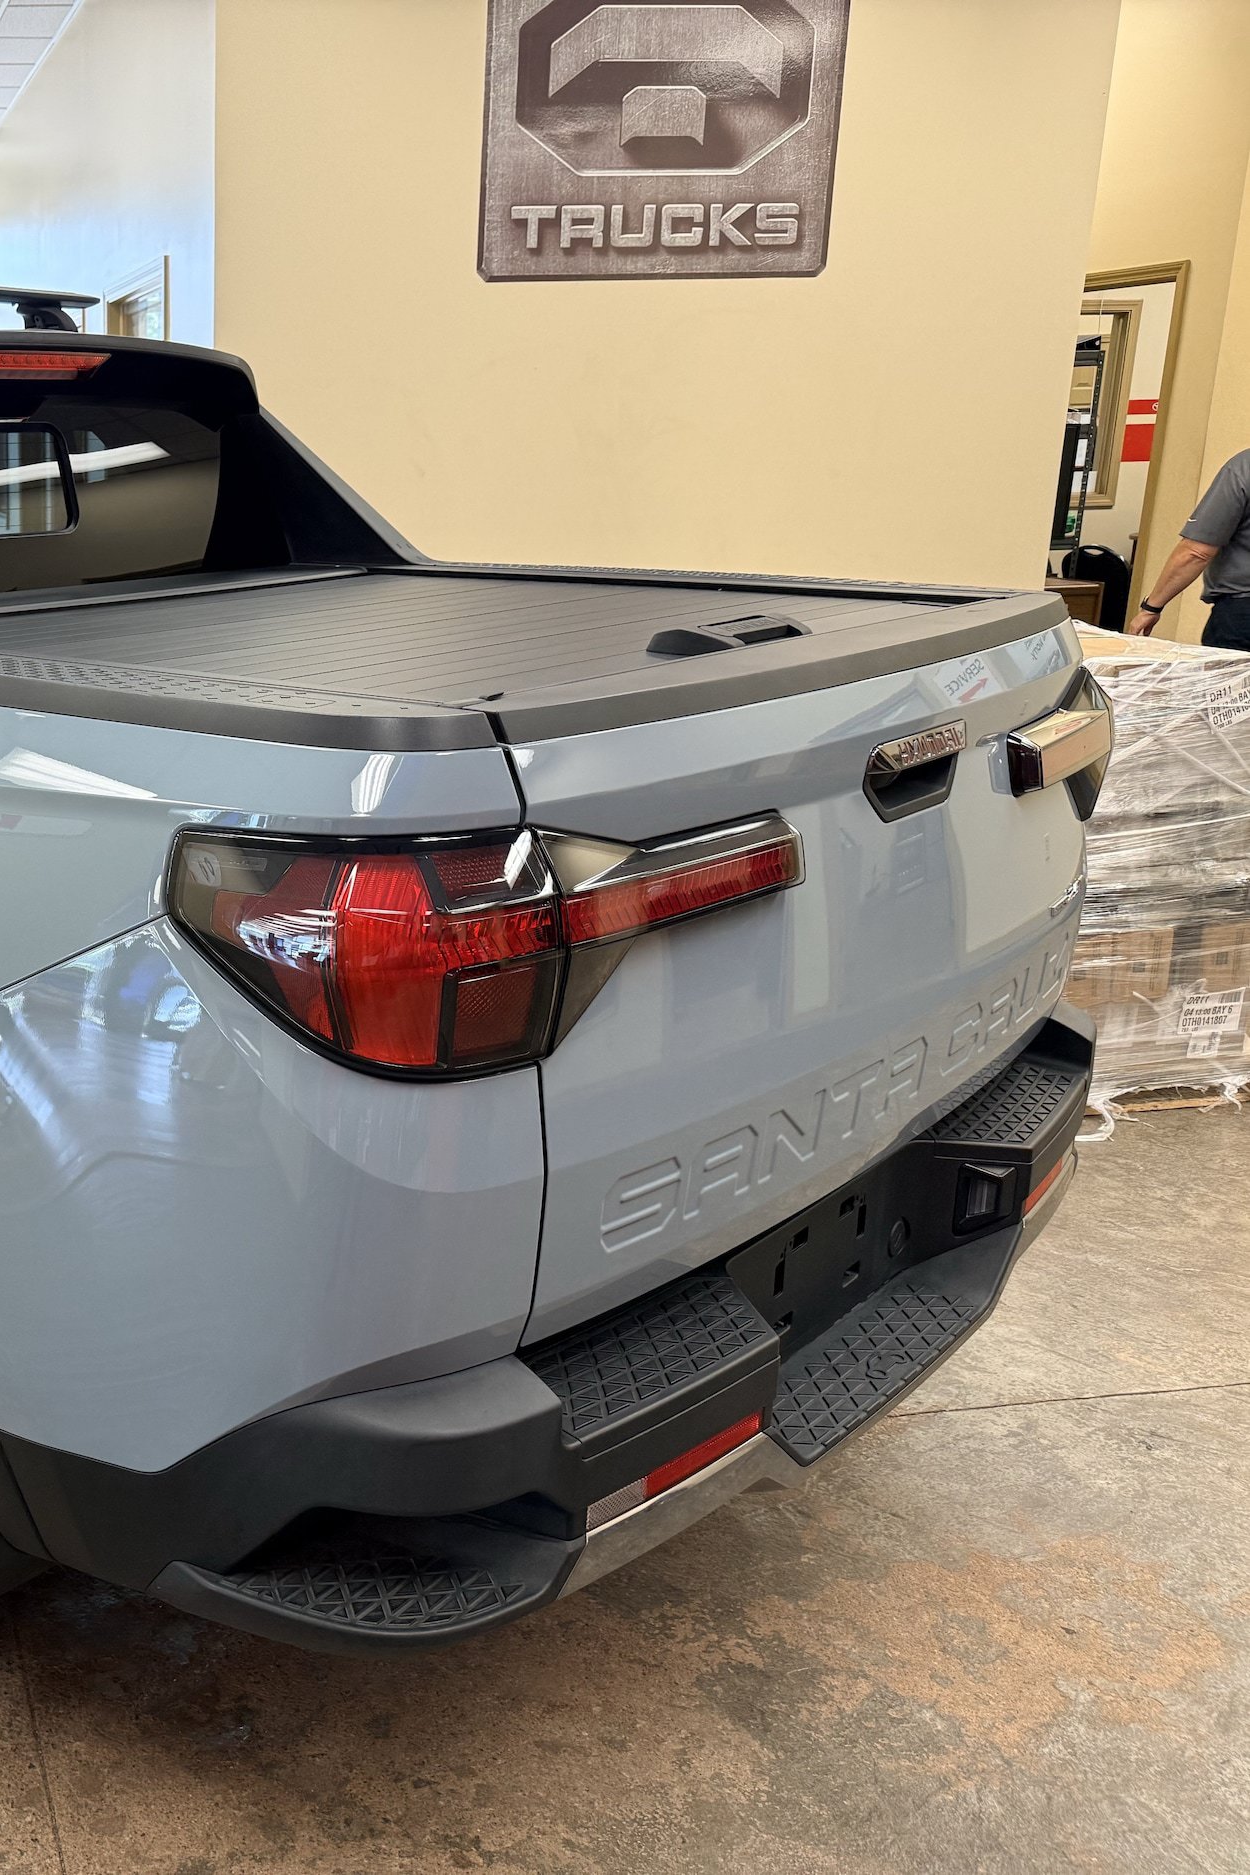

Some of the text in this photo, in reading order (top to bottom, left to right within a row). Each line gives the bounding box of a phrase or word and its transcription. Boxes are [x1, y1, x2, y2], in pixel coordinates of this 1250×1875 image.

[510, 202, 800, 250] TRUCKS
[1211, 1005, 1227, 1015] BAY
[600, 932, 1070, 1254] SANTA CRUZ
